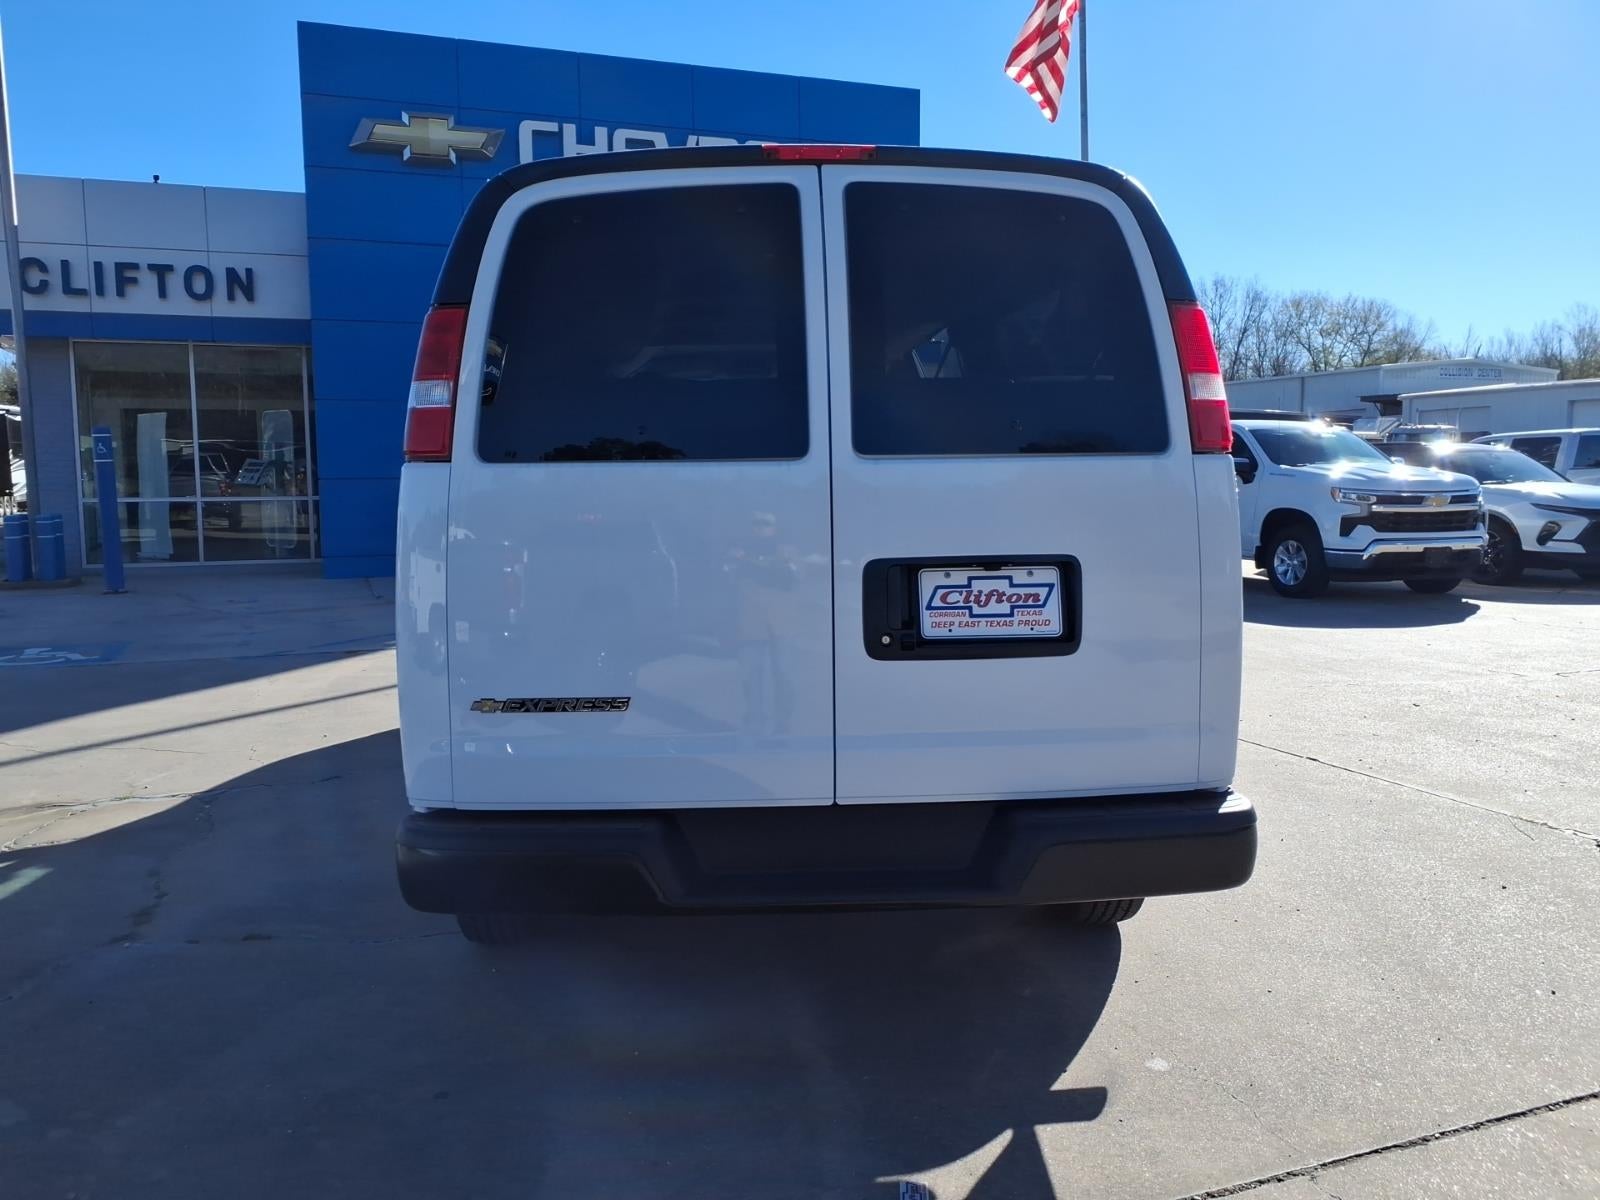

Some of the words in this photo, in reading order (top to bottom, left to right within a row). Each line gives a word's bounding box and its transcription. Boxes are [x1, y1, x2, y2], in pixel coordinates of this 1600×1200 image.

[19, 256, 255, 303] CLIFTON
[1440, 367, 1473, 377] COLLISION
[1477, 368, 1502, 378] CENTER
[940, 588, 1042, 608] Clifton
[1016, 609, 1043, 617] TEXAS
[931, 621, 956, 629] DEEP
[958, 620, 982, 628] EAST
[985, 619, 1015, 628] TEXAS
[1017, 619, 1052, 627] PROUD
[502, 698, 630, 712] EXPRESS
